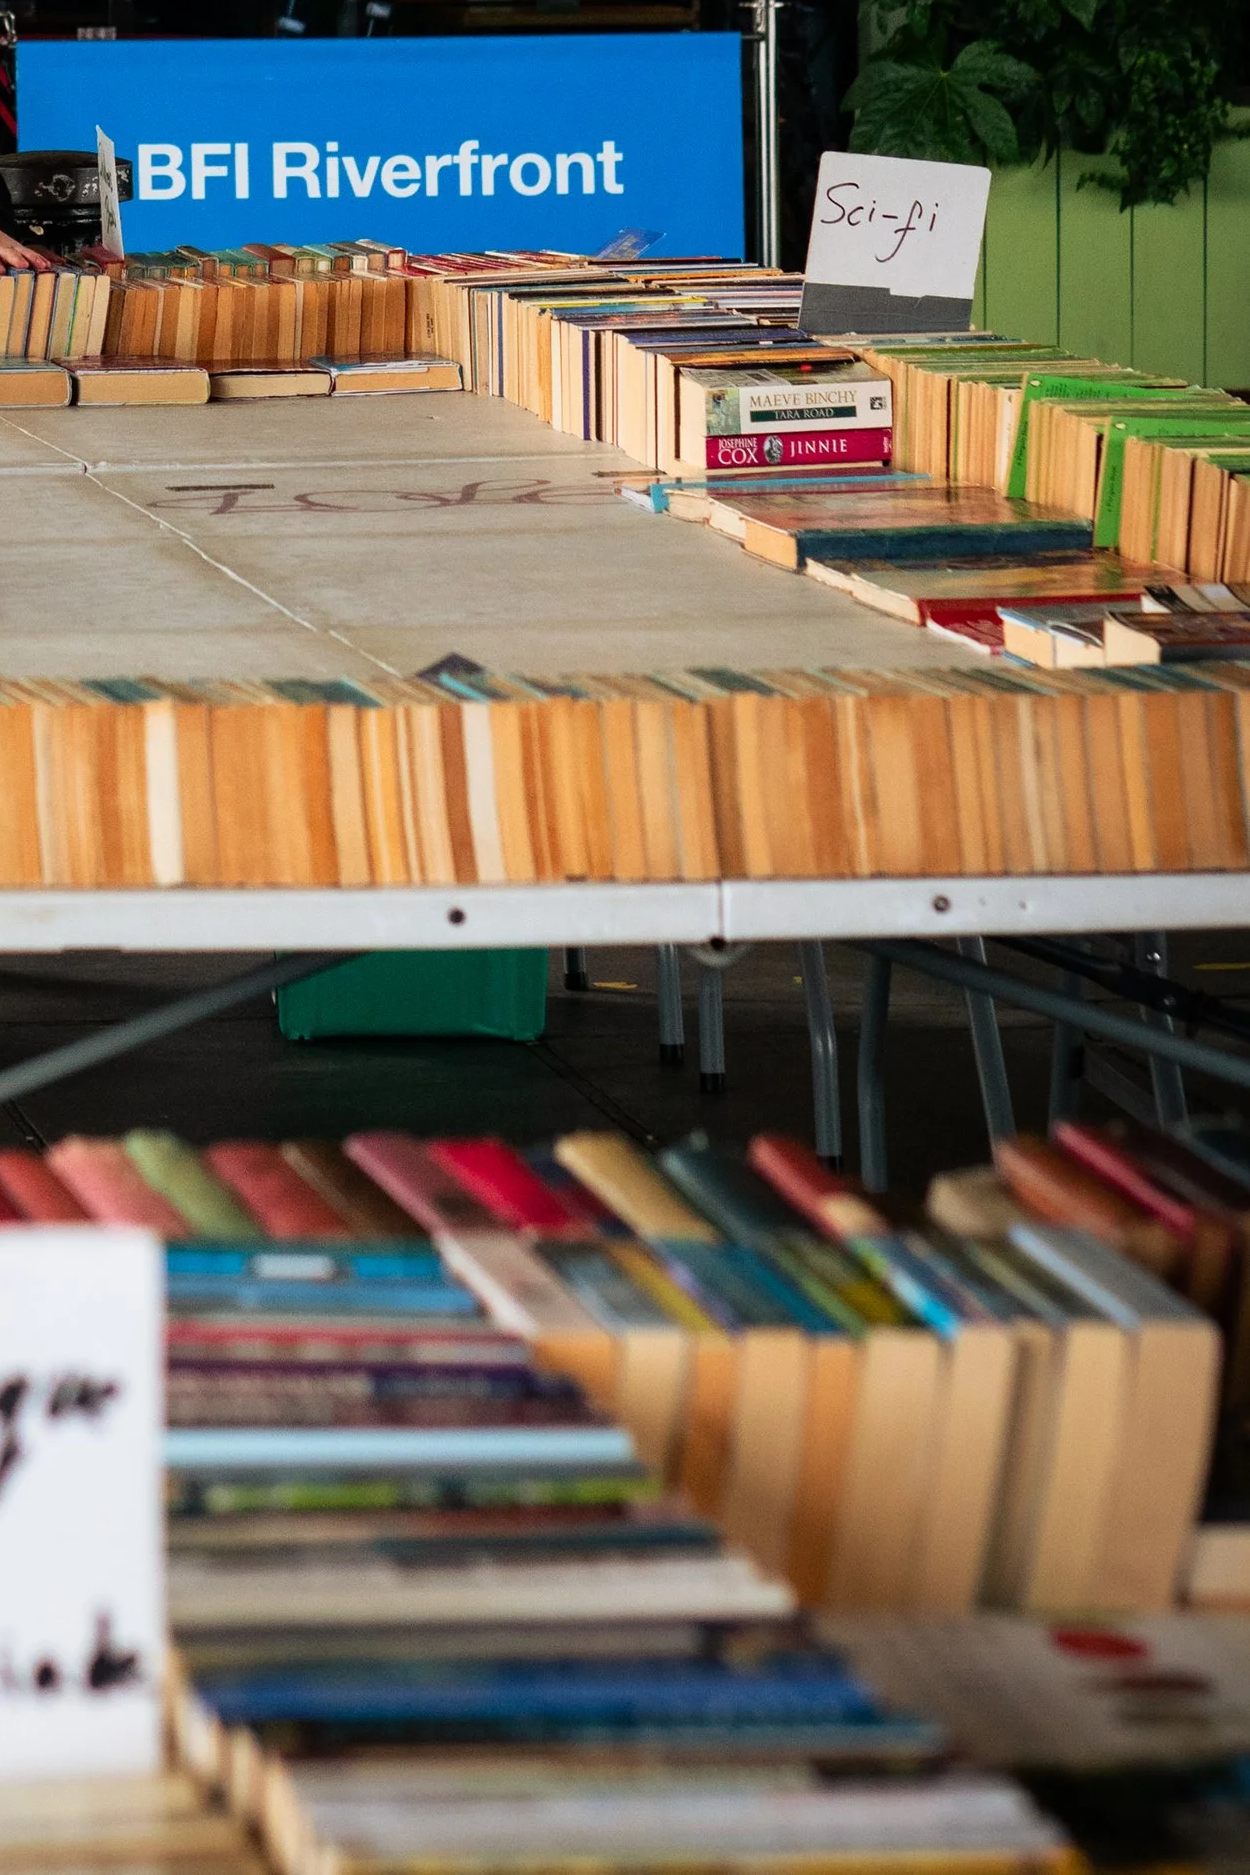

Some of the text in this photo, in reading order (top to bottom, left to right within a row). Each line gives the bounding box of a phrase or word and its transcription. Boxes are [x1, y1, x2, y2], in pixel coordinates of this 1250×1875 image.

[138, 142, 250, 201] BFI
[272, 139, 625, 200] Riverfront
[820, 182, 939, 263] Sci-fi
[750, 390, 858, 408] MAEVE BINCHY
[774, 407, 835, 420] TARA ROAD
[718, 437, 758, 449] JOSEPHINE
[790, 438, 848, 457] JINNIE
[717, 448, 759, 465] COX
